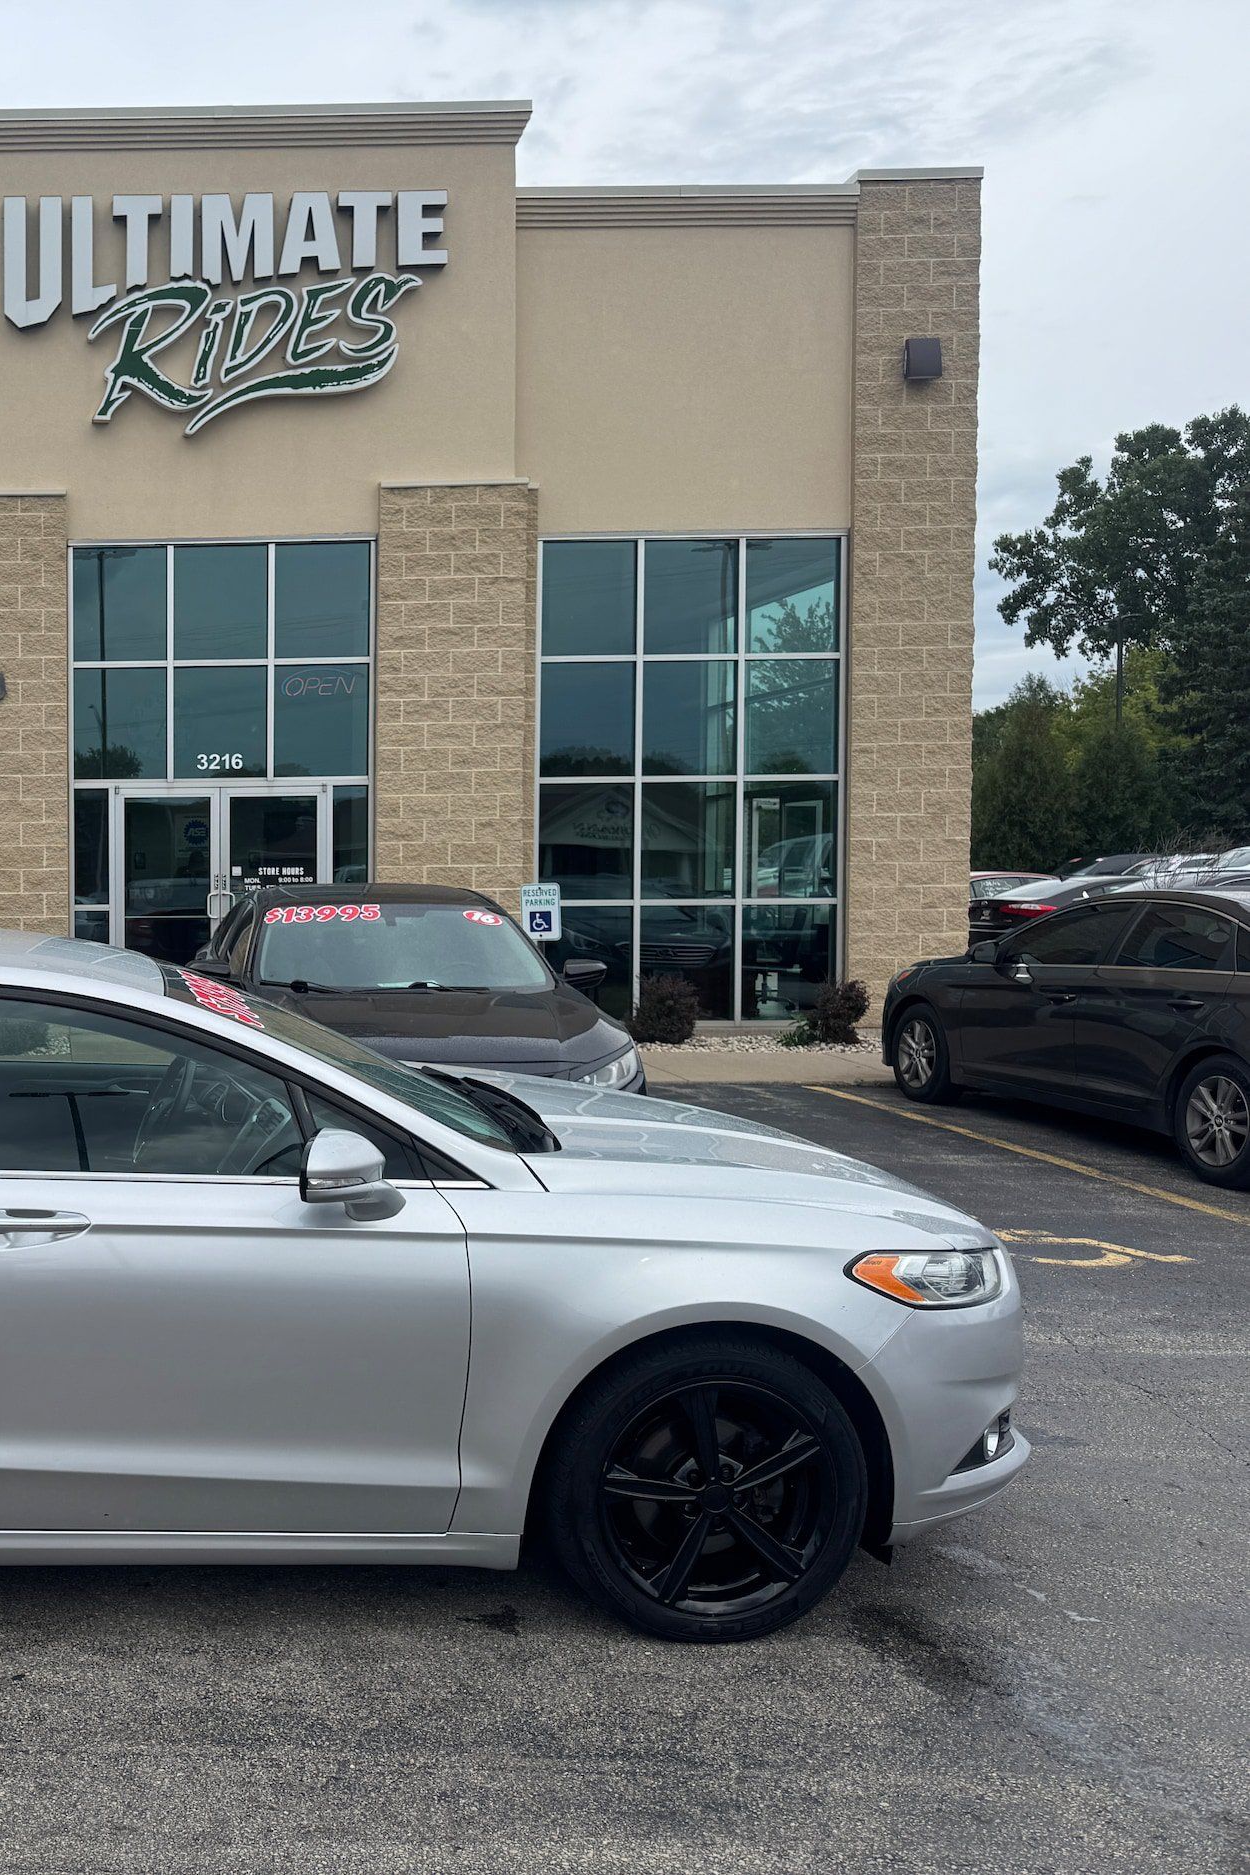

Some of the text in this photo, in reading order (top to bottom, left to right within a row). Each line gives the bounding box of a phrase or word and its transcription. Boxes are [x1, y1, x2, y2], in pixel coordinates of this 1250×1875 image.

[3, 190, 448, 329] ULTIMATE
[285, 675, 356, 696] OPEN
[196, 753, 243, 770] 3216
[258, 867, 304, 875] STORE HOURS
[523, 889, 557, 897] RESERVED
[525, 898, 555, 906] PARKING
[264, 904, 381, 924] $13995
